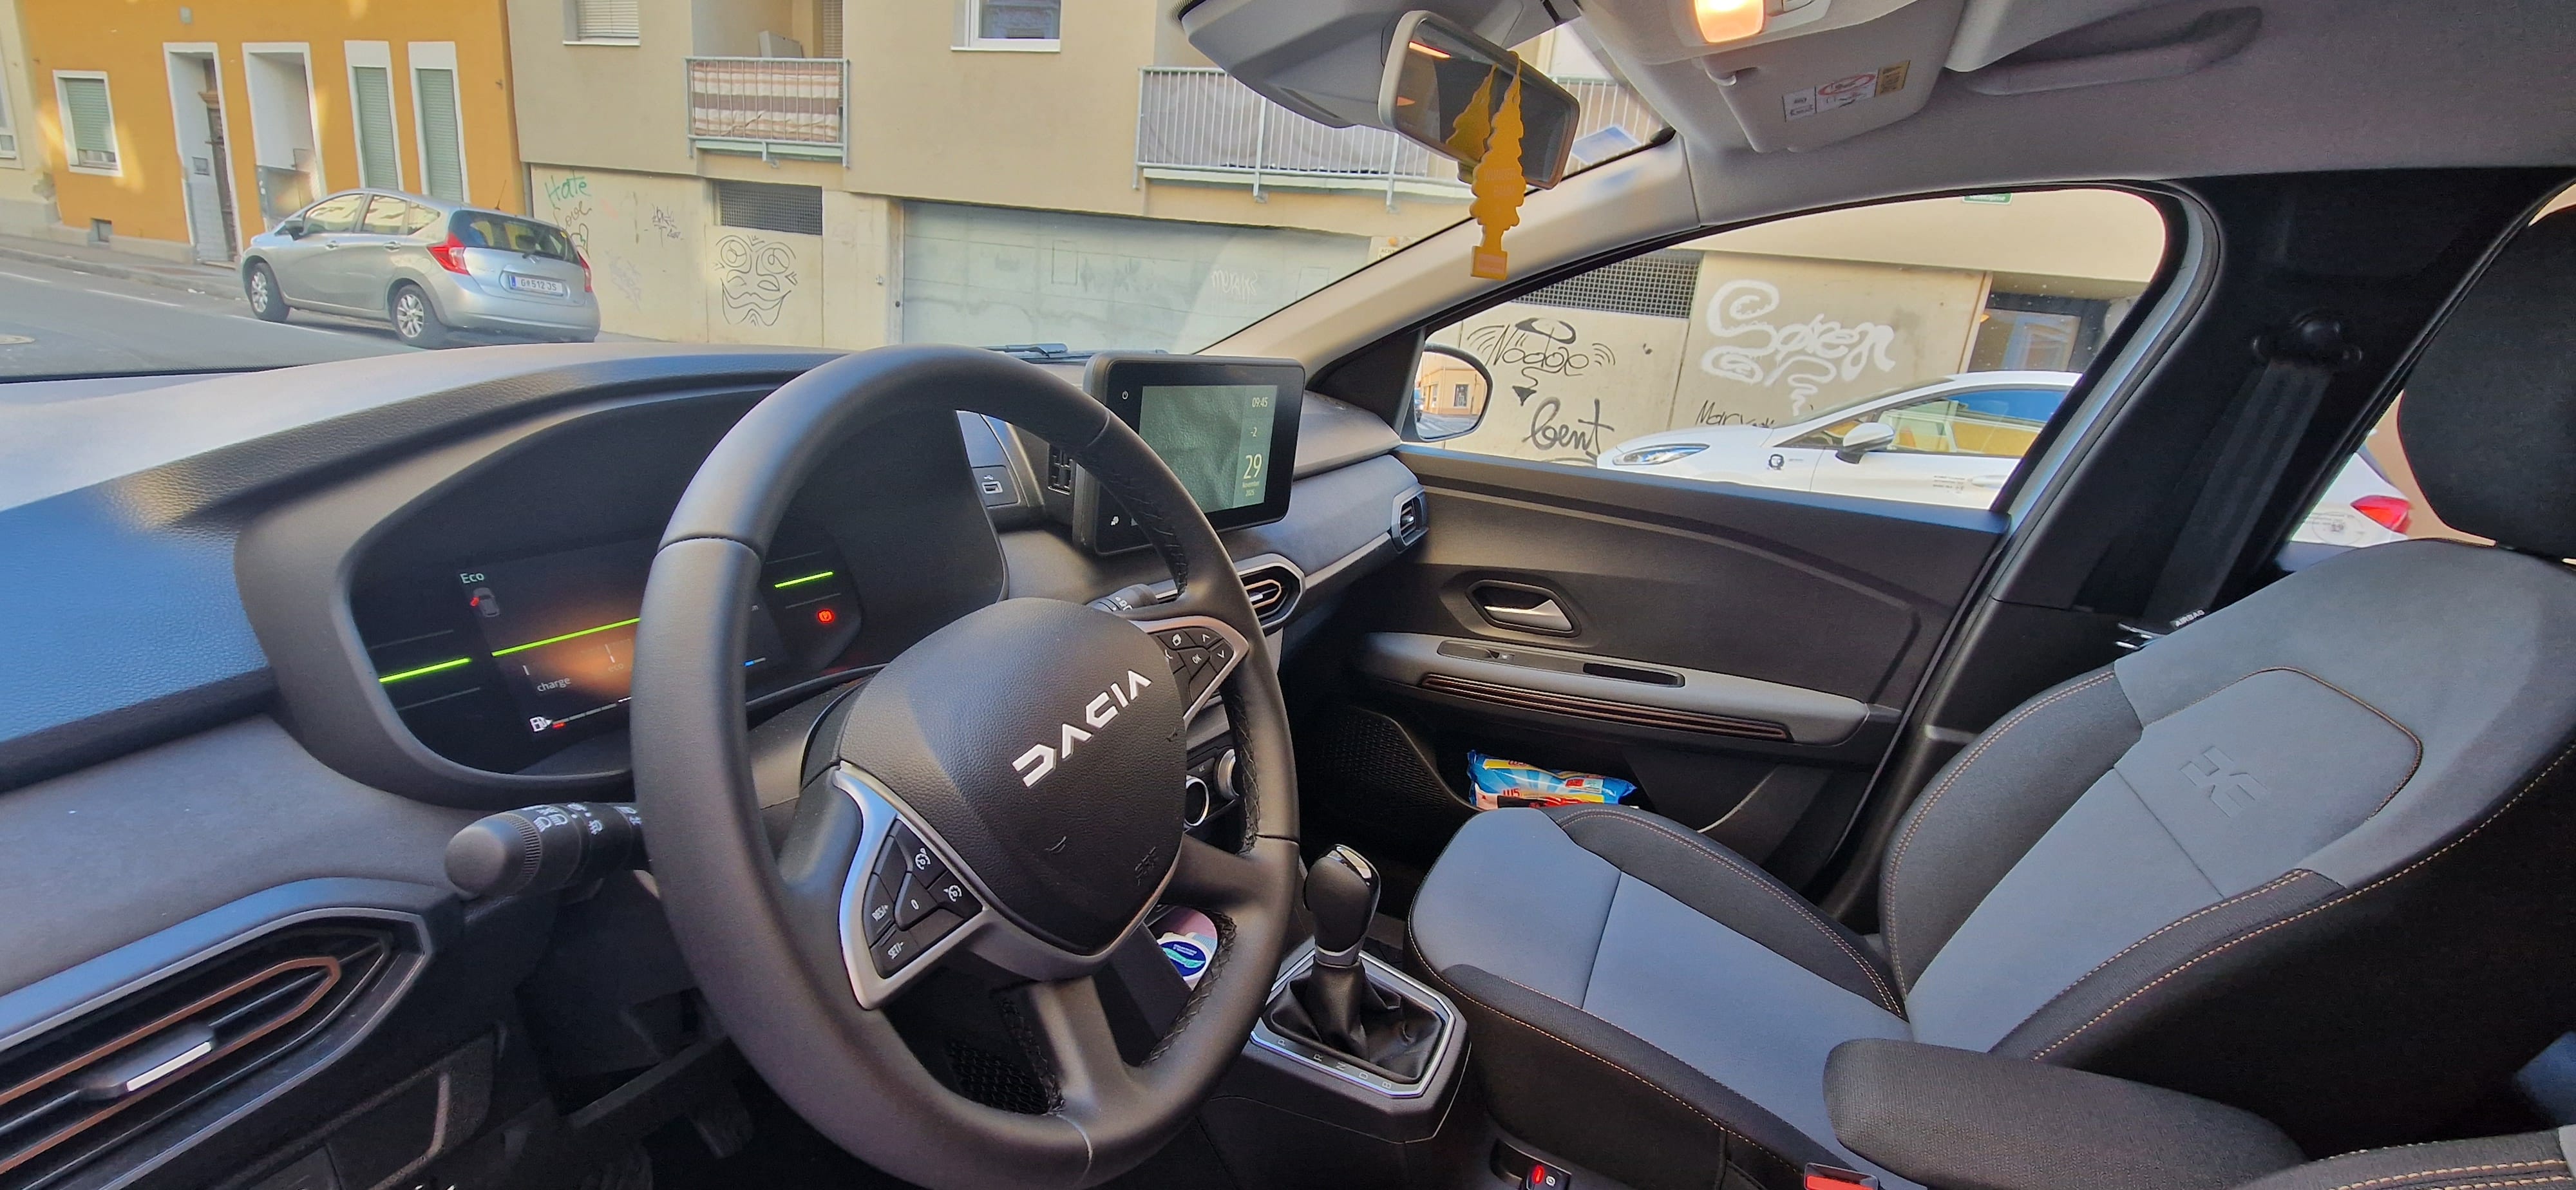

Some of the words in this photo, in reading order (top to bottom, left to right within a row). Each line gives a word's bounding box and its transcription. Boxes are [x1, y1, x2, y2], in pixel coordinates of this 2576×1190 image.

[531, 279, 545, 290] 512
[1251, 397, 1268, 408] 09:45
[1250, 427, 1258, 437] -2
[1243, 453, 1262, 480] 29
[460, 572, 485, 584] Eco
[2175, 609, 2205, 627] AIRBAG
[1192, 654, 1202, 664] OK
[607, 663, 624, 673] eco
[537, 677, 572, 693] charge
[1012, 669, 1153, 788] DACIA
[1313, 1053, 1323, 1062] R
[1336, 1062, 1347, 1071] N
[1358, 1072, 1368, 1080] D
[1382, 1081, 1392, 1090] B
